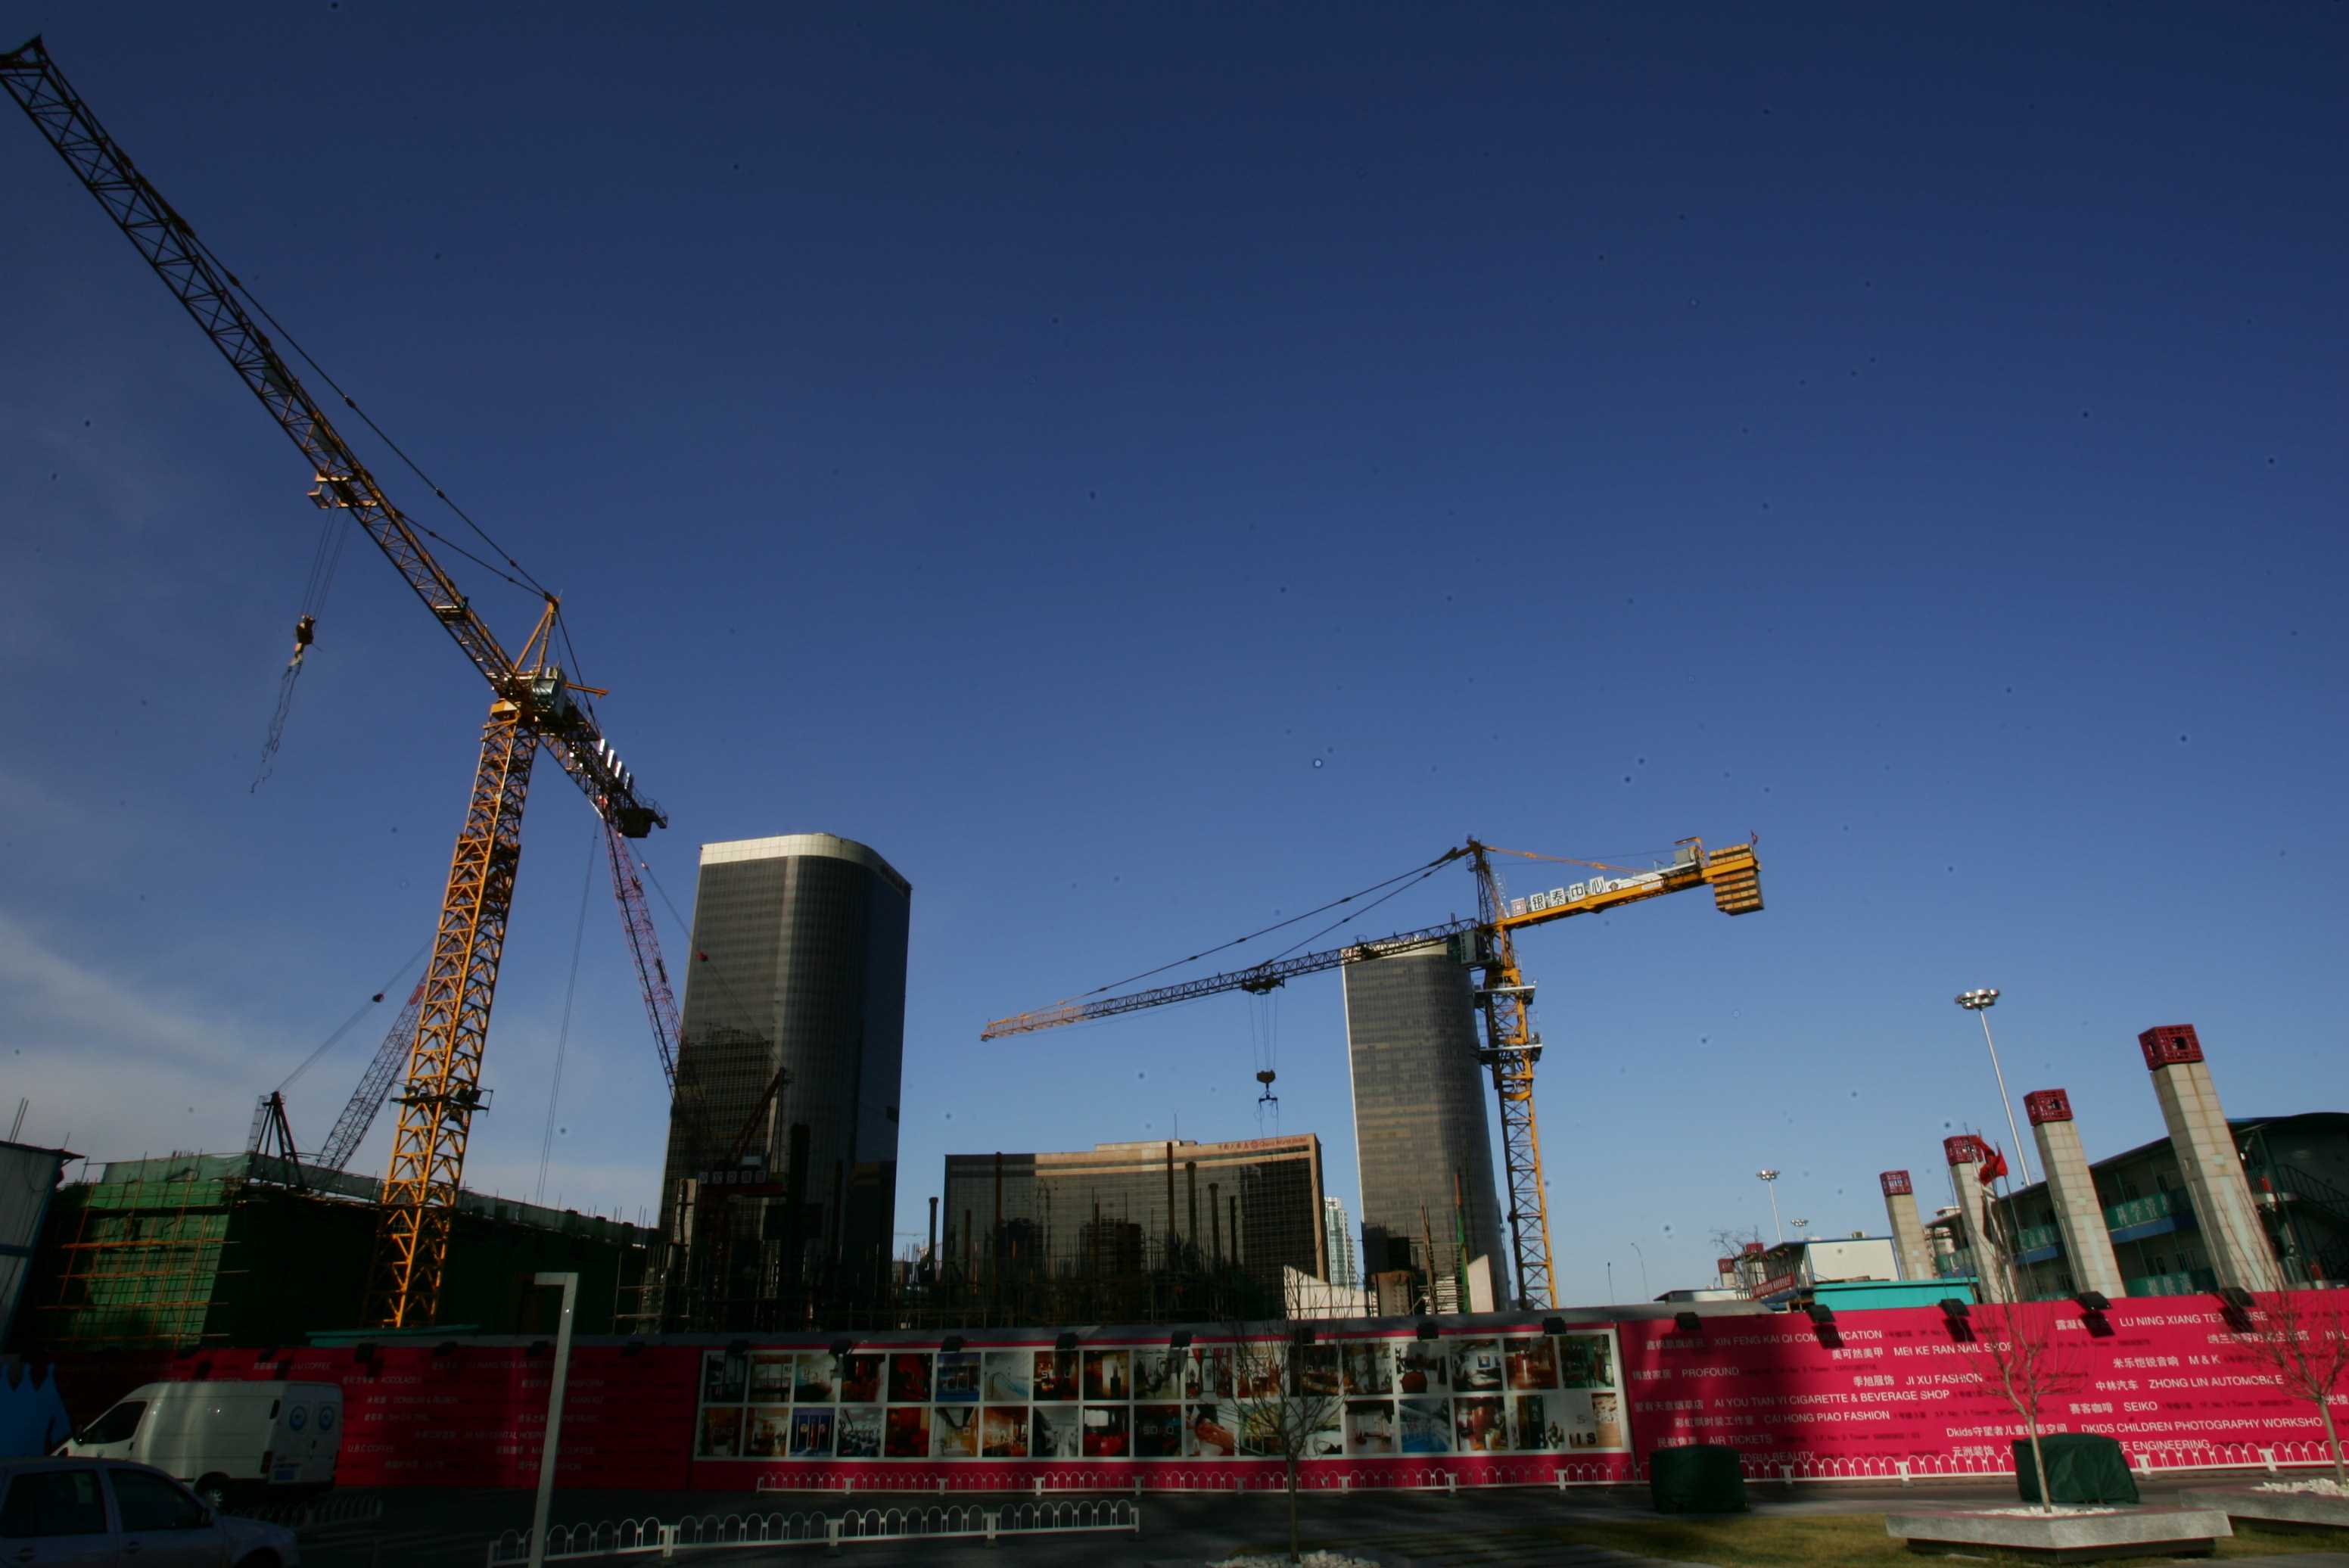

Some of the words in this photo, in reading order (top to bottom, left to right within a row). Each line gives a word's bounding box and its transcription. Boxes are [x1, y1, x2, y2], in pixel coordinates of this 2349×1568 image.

[2119, 1317, 2134, 1327] LU
[2136, 1315, 2164, 1326] NING
[2167, 1314, 2201, 1325] XIANG
[1733, 1336, 1760, 1345] FENG
[1763, 1334, 1779, 1343] KAI
[1893, 1346, 1913, 1356] MEI
[1915, 1345, 1929, 1355] KE
[1933, 1344, 1955, 1354] RAN
[2189, 1355, 2198, 1365] M
[2212, 1355, 2221, 1364] K
[1682, 1367, 1739, 1377] PROFOUND
[1906, 1376, 1915, 1385] JI
[1917, 1376, 1932, 1385] XU
[1934, 1373, 1983, 1384] FASHION
[2148, 1378, 2188, 1389] ZHONG
[2190, 1377, 2208, 1387] LIN
[1714, 1398, 1724, 1407] AI
[1725, 1398, 1748, 1407] YOU
[1750, 1397, 1774, 1406] TIAN
[1789, 1393, 1848, 1405] CIGARETTE
[1851, 1393, 1858, 1402] &
[1861, 1390, 1918, 1402] BEVERAGE
[1921, 1389, 1949, 1399] SHOP
[2123, 1401, 2158, 1411] SEIKO
[1764, 1414, 1781, 1423] CAI
[1784, 1413, 1814, 1423] HONG
[1817, 1412, 1841, 1422] PIAO
[1843, 1410, 1890, 1421] FASHION
[2117, 1421, 2172, 1432] CHILDREN
[2175, 1417, 2260, 1431] PHOTOGRAPHY
[2262, 1416, 2326, 1428] WORKSHO
[1709, 1436, 1726, 1445] AIR
[1729, 1435, 1772, 1445] TICKETS
[2133, 1439, 2211, 1451] ENGINEERING
